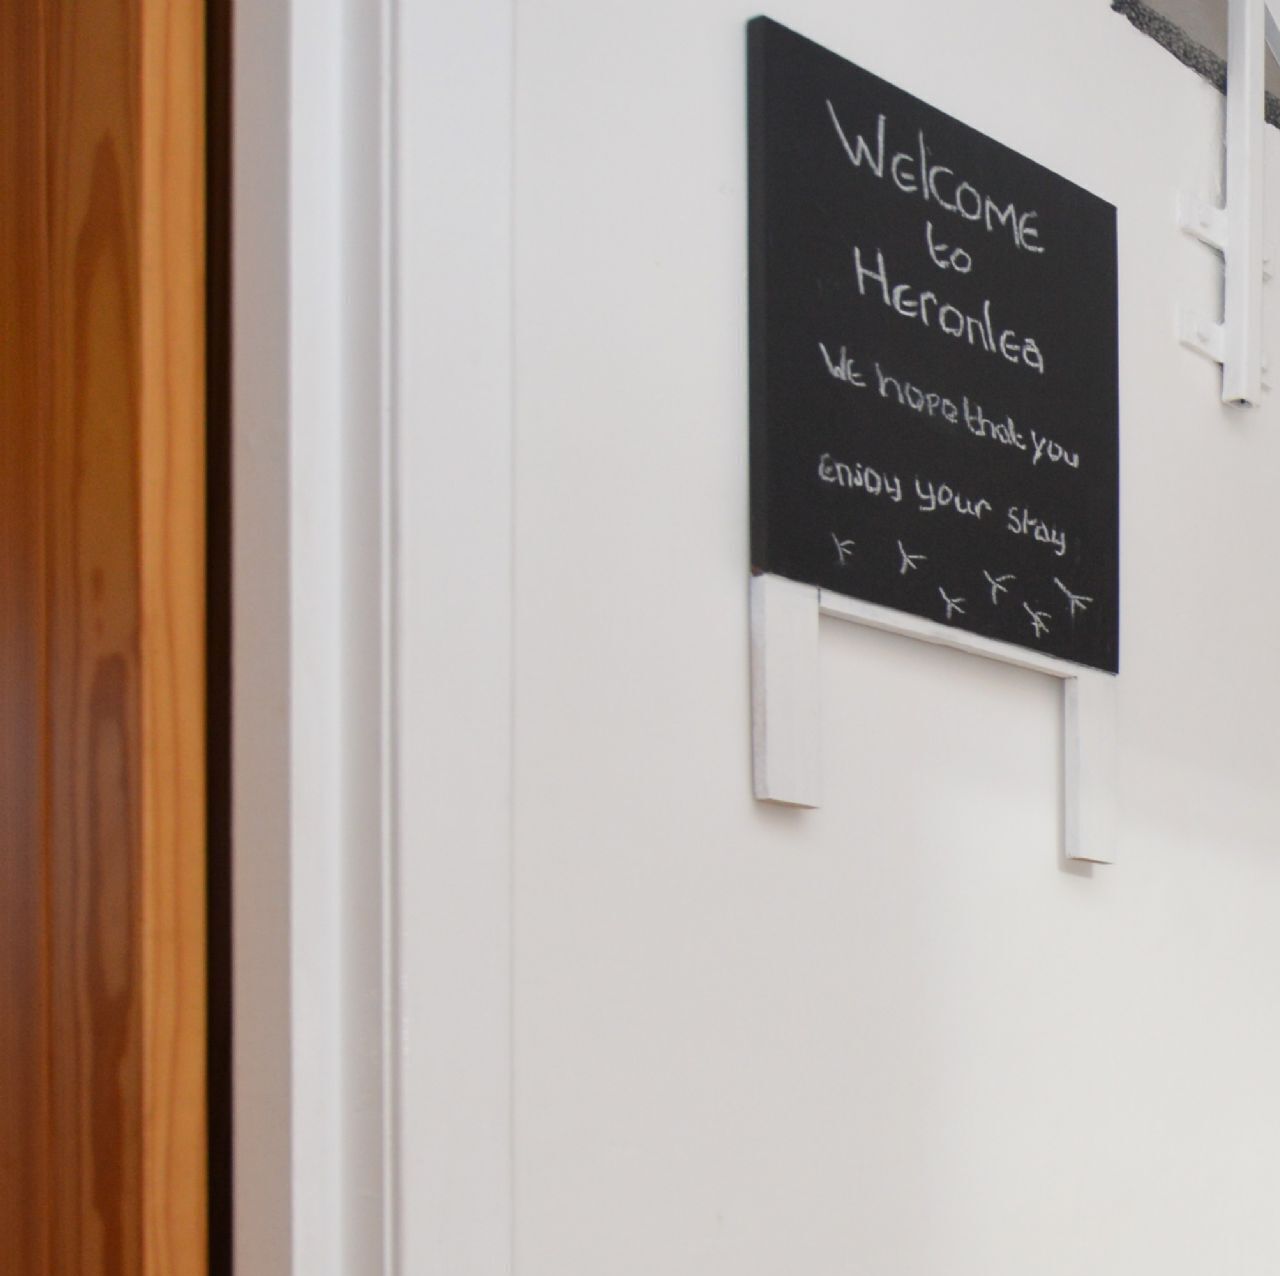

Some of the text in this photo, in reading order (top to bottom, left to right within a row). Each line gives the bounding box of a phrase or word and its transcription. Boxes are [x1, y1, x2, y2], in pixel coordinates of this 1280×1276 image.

[927, 220, 972, 273] to
[818, 341, 1080, 469] We hope that you
[915, 474, 992, 519] your
